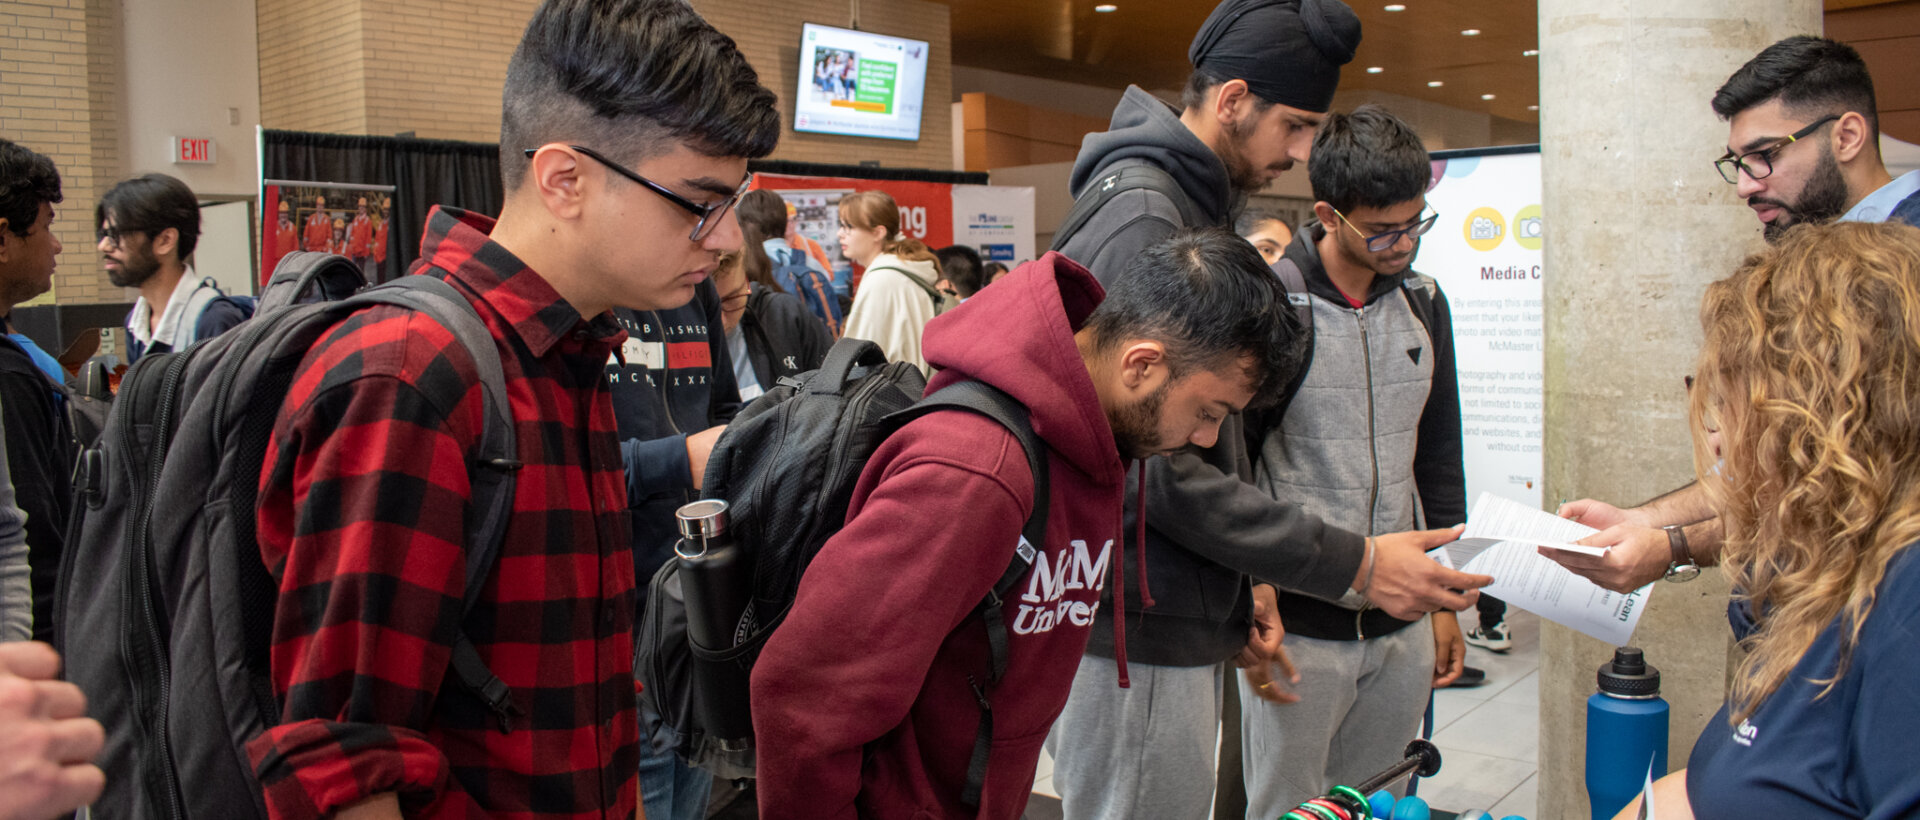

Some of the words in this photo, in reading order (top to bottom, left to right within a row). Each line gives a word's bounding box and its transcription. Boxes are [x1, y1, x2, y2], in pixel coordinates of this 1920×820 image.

[181, 138, 209, 161] EXIT
[1480, 266, 1526, 280] Media
[1531, 265, 1541, 280] C
[1454, 297, 1464, 309] By
[1467, 298, 1503, 310] entering
[1504, 298, 1521, 308] this
[1481, 312, 1499, 322] that
[1501, 314, 1519, 324] your
[1455, 327, 1478, 338] photo
[1480, 327, 1496, 337] and
[1499, 327, 1522, 337] video
[1488, 340, 1534, 352] McMaster
[1509, 370, 1525, 381] and
[1461, 384, 1485, 394] forms
[1487, 384, 1496, 394] of
[1465, 399, 1479, 408] not
[1481, 398, 1511, 409] limited
[1512, 400, 1522, 409] to
[1463, 427, 1480, 436] and
[1486, 441, 1520, 453] without
